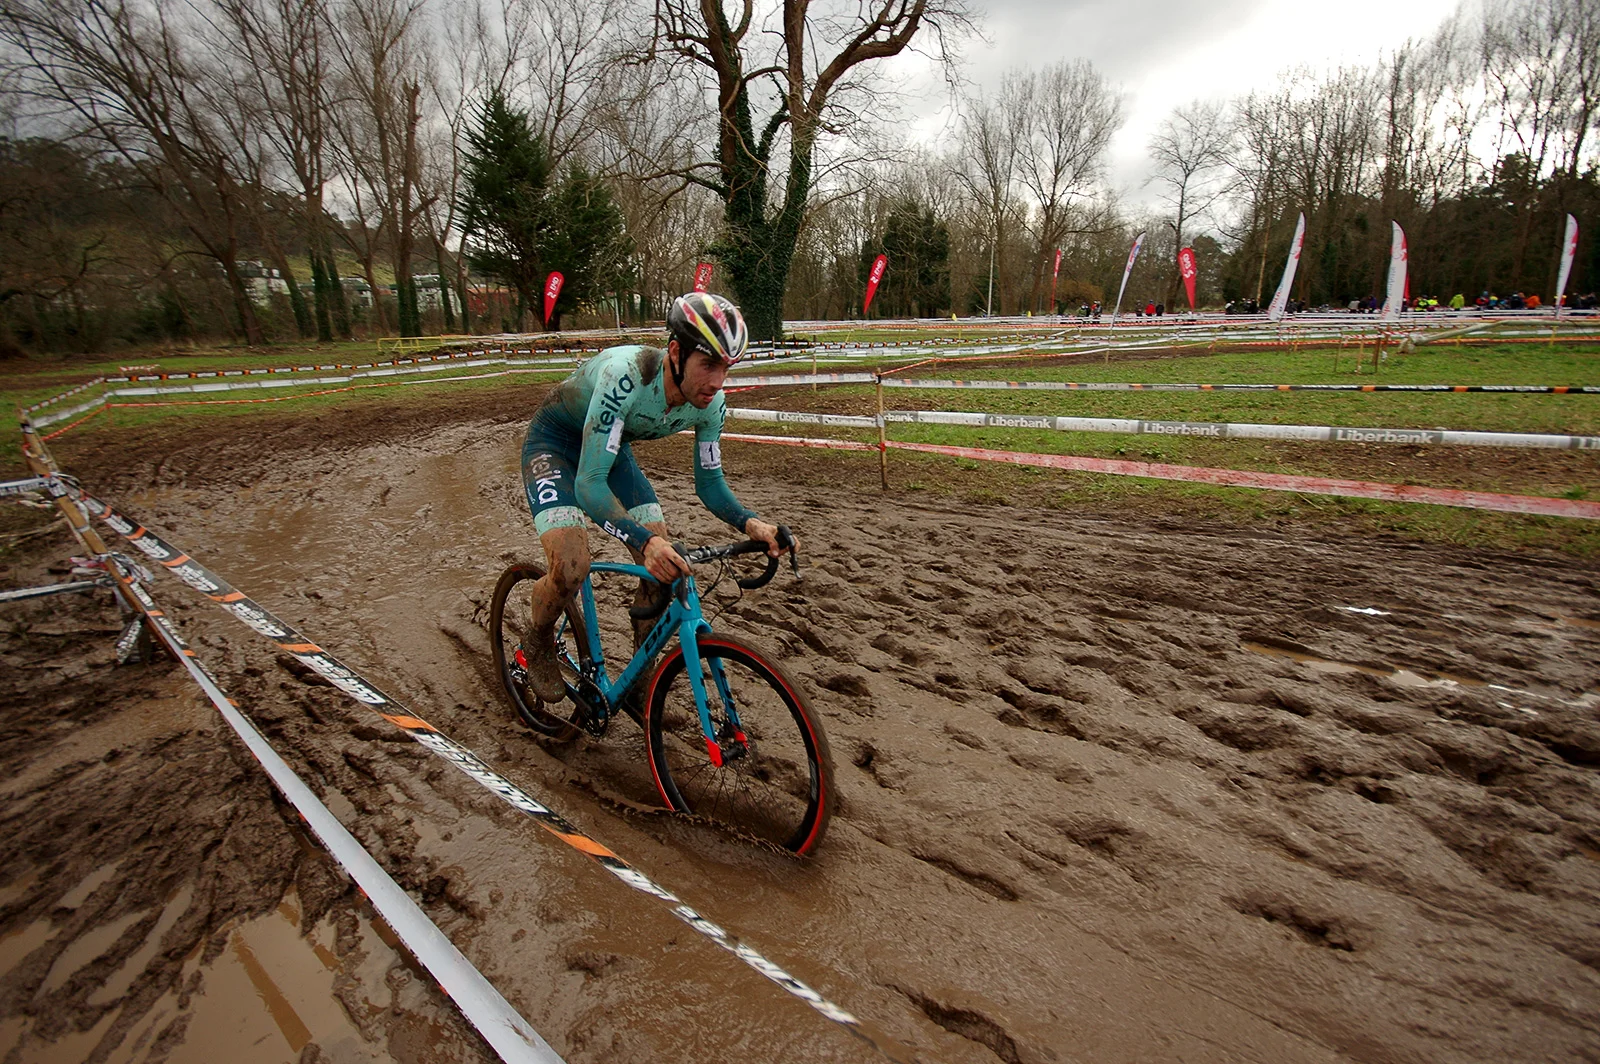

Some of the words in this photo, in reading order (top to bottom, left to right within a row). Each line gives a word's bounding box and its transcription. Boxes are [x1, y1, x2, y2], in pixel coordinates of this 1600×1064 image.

[592, 374, 634, 434] teika
[779, 412, 820, 424] Liberbank
[989, 415, 1052, 429] Liberbank
[1143, 422, 1221, 436] Liberbank
[1336, 429, 1434, 444] Liberbank
[707, 443, 714, 461] 1
[530, 453, 562, 505] teika
